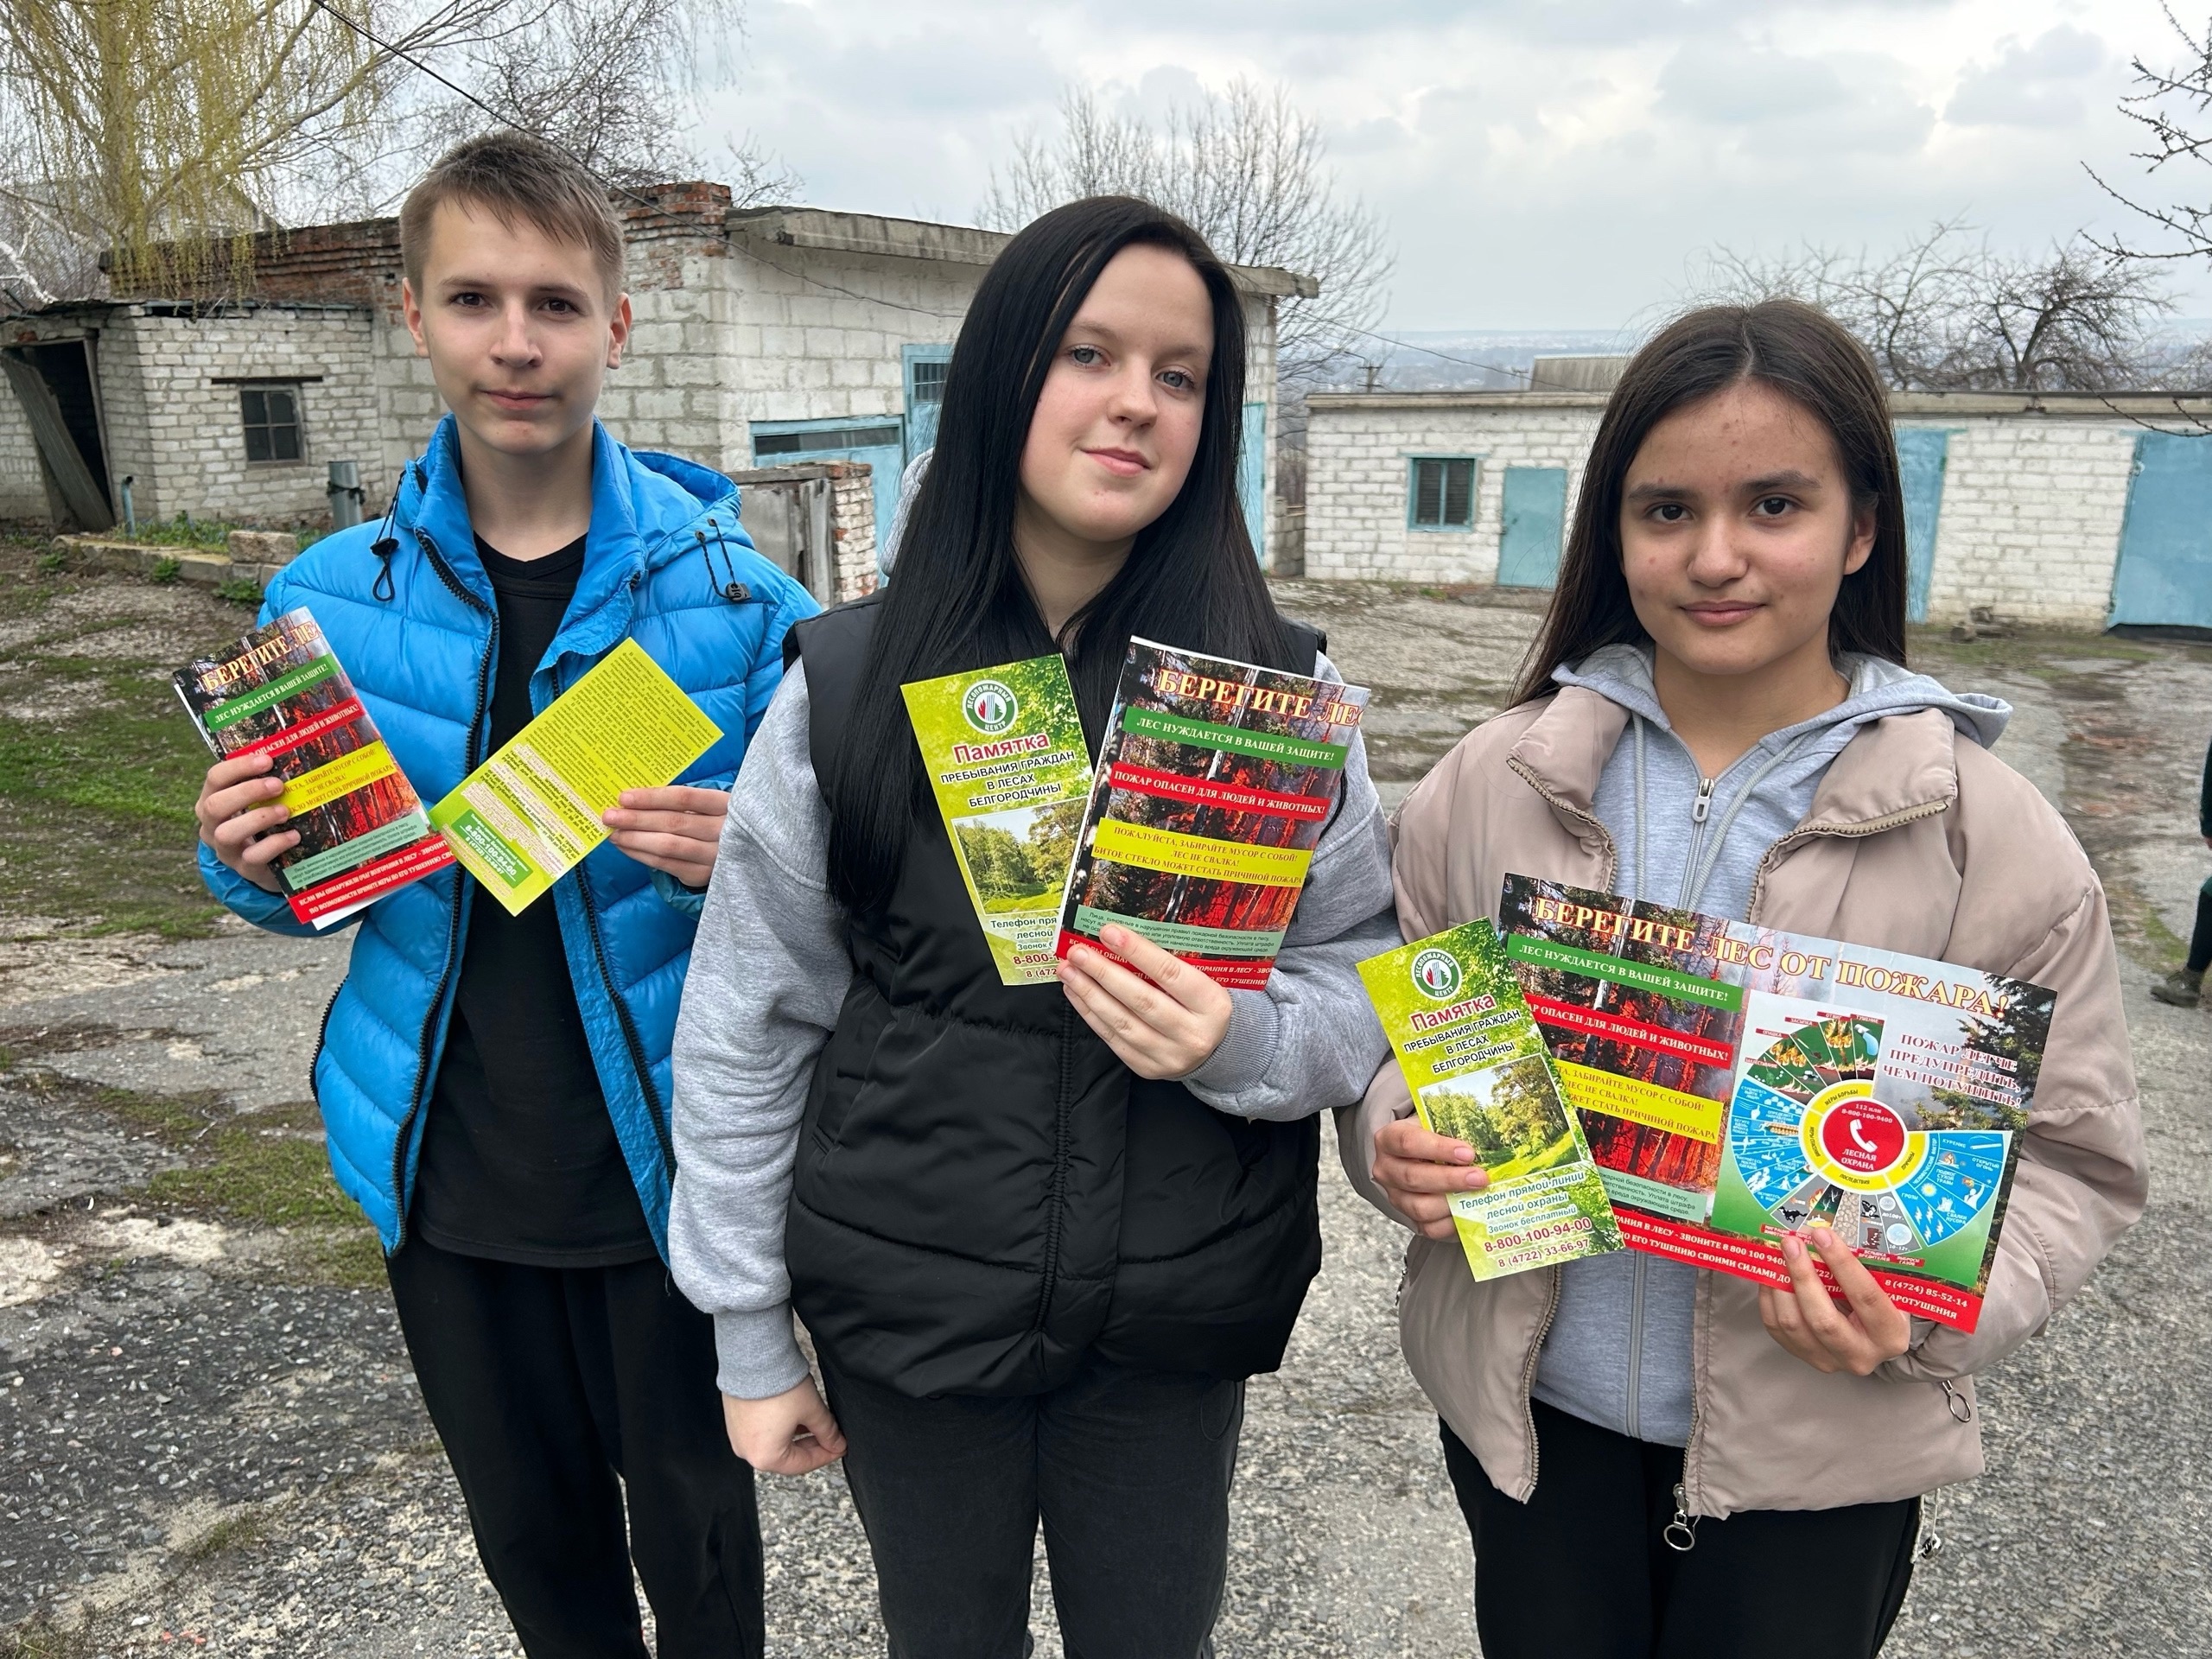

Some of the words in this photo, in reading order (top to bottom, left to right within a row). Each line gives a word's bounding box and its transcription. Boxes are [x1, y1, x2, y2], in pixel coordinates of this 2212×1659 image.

[200, 633, 293, 692] БЕРЕГИТЕ
[213, 709, 232, 723] ЛЕС
[229, 689, 276, 716] НУЖДАЕТСЯ
[277, 675, 303, 692] ВАШЕЙ
[299, 663, 329, 682] ЗАЩИТЕ!
[1155, 668, 1313, 720] БЕРЕГИТЕ
[283, 733, 299, 744] ДЛЯ
[296, 721, 321, 738] ЛЮДЕЙ
[322, 702, 359, 725] ЖИВОТНЫХ!
[985, 721, 1006, 731] ЦЕНТР
[954, 734, 1050, 763] Памятка
[1135, 715, 1161, 730] ЛЕС
[1161, 721, 1233, 746] НУЖДАЕТСЯ
[1234, 736, 1243, 746] В
[1243, 734, 1286, 754] ВАШЕЙ
[1285, 743, 1335, 764] ЗАЩИТЕ!
[941, 763, 1019, 783] ПРЕБЫВАНИЯ
[1020, 752, 1075, 770] ГРАЖДАН
[987, 781, 995, 790] В
[997, 774, 1035, 788] ЛЕСАХ
[969, 784, 1062, 807] БЕЛГОРОДЧИНЫ
[1114, 770, 1153, 785] ПОЖАР
[1152, 779, 1196, 795] ОПАСЕН
[1195, 786, 1220, 800] ДЛЯ
[1218, 788, 1257, 807] ЛЮДЕЙ
[1256, 797, 1266, 807] И
[1265, 795, 1325, 818] ЖИВОТНЫХ!
[1113, 825, 1179, 847] ПОЖАЛУЙСТА,
[1179, 838, 1228, 855] ЗАБИРАЙТЕ
[1228, 846, 1259, 860] МУСОР
[1266, 849, 1298, 864] СОБОЙ!
[1170, 849, 1189, 860] ЛЕС
[1189, 852, 1202, 861] НЕ
[1202, 854, 1240, 868] СВАЛКА!
[1093, 846, 1123, 859] БИТОЕ
[1124, 851, 1161, 866] СТЕКЛО
[1161, 859, 1195, 872] МОЖЕТ
[1195, 864, 1222, 875] СТАТЬ
[1223, 866, 1270, 884] ПРИЧИНОЙ
[1269, 872, 1302, 887] ПОЖАРА
[991, 918, 1036, 928] Телефон
[1036, 969, 1057, 977] (472
[1519, 944, 1542, 957] ЛЕС
[1544, 950, 1616, 975] НУЖДАЕТСЯ
[1618, 967, 1626, 976] В
[1627, 967, 1671, 987] ВАШЕЙ
[1672, 979, 1728, 1002] ЗАЩИТЕ!
[1535, 896, 1696, 954] БЕРЕГИТЕ
[1701, 936, 1774, 970] ЛЕС
[1780, 950, 1831, 981] ОТ
[1835, 960, 2009, 1019] ПОЖАРА!
[1434, 985, 1453, 996] ЦЕНТР
[1411, 995, 1496, 1031] Памятка
[1404, 1025, 1471, 1052] ПРЕБЫВАНИЯ
[1473, 1010, 1521, 1031] ГРАЖДАН
[1446, 1046, 1453, 1054] В
[1456, 1035, 1489, 1052] ЛЕСАХ
[1540, 1006, 1582, 1023] ОПАСЕН
[1584, 1016, 1606, 1030] ДЛЯ
[1607, 1020, 1648, 1039] ЛЮДЕЙ
[1649, 1033, 1657, 1041] И
[1658, 1035, 1728, 1060] ЖИВОТНЫХ!
[1433, 1042, 1515, 1073] БЕЛГОРОДЧИНЫ
[1900, 1033, 1960, 1055] ПОЖАР
[1961, 1047, 2018, 1073] ЛЕГЧЕ
[1573, 1070, 1623, 1089] ЗАБИРАЙТЕ
[1624, 1084, 1658, 1099] МУСОР
[1668, 1095, 1704, 1111] СОБОЙ!
[1584, 1084, 1597, 1094] НЕ
[1598, 1089, 1638, 1105] СВАЛКА!
[1825, 1093, 1837, 1105] МЕРЫ
[1838, 1090, 1858, 1098] БОРЬБЫ
[1881, 1065, 1918, 1082] ЧЕМ
[1921, 1072, 2022, 1109] ПОТУШИТЬ!
[1592, 1099, 1620, 1113] СТАТЬ
[1622, 1106, 1675, 1128] ПРИЧИНОЙ
[1675, 1122, 1715, 1139] ПОЖАРА
[1841, 1109, 1892, 1123] 8-800-100-9400
[1841, 1158, 1874, 1170] ОХРАНА
[1842, 1149, 1877, 1161] ЛЕСНАЯ
[1459, 1192, 1506, 1210] Телефон
[1509, 1181, 1549, 1200] прямой
[1551, 1172, 1584, 1186] линии
[1626, 1179, 1667, 1195] безопасности
[1649, 1192, 1669, 1203] Уплата
[1670, 1199, 1695, 1210] штрафа
[1487, 1204, 1524, 1220] лесной
[1527, 1193, 1567, 1211] охраны
[1488, 1221, 1519, 1233] Звонок
[1521, 1207, 1577, 1225] бесплатный
[1630, 1195, 1669, 1211] окружающей
[1670, 1207, 1689, 1216] среде.
[1484, 1217, 1592, 1252] 8-800-100-94-00
[1508, 1250, 1542, 1266] (4722)
[1544, 1239, 1589, 1255] 33-66-97
[1651, 1225, 1674, 1236] ЛЕСУ
[1680, 1232, 1722, 1249] ЗВОНИТЕ
[1730, 1245, 1747, 1255] 800
[1749, 1250, 1764, 1260] 100
[1892, 1281, 1924, 1294] (4724)
[1925, 1288, 1967, 1307] 85-52-14
[1631, 1236, 1648, 1244] ЕГО
[1649, 1240, 1696, 1257] ТУШЕНИЮ
[1698, 1251, 1736, 1268] СВОИМИ
[1737, 1262, 1776, 1279] СИЛАМИ
[1777, 1274, 1791, 1284] ДО
[1885, 1294, 1957, 1319] АРОТУШЕНИЯ
